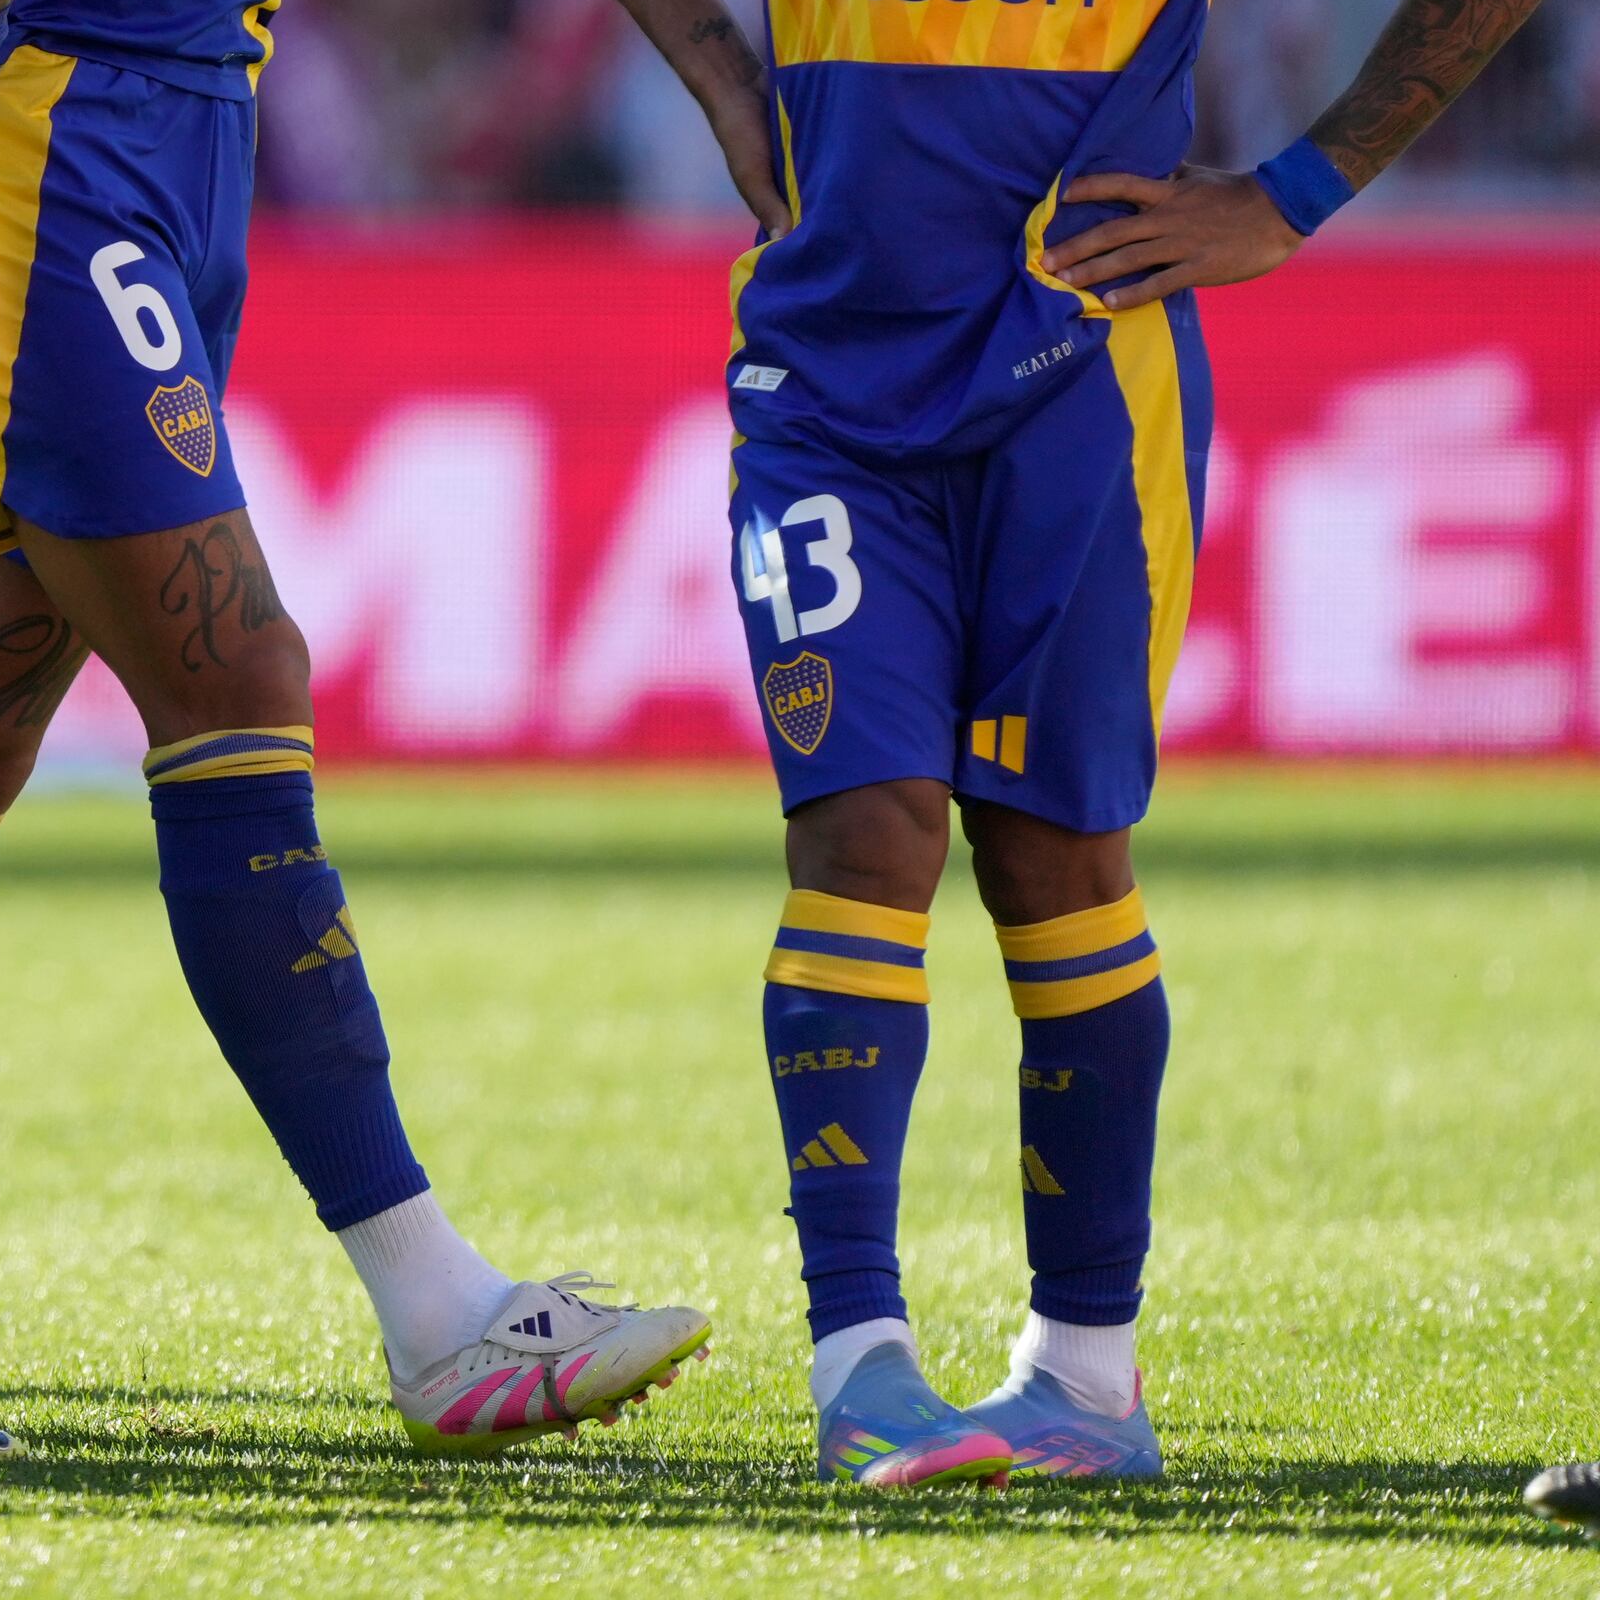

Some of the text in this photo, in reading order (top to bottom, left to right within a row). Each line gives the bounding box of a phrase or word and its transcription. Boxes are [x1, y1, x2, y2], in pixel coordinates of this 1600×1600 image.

[90, 240, 182, 371] 6
[162, 406, 209, 438] CABJ
[740, 493, 862, 645] 43
[774, 681, 826, 716] CABJ
[774, 1046, 881, 1078] CABJ
